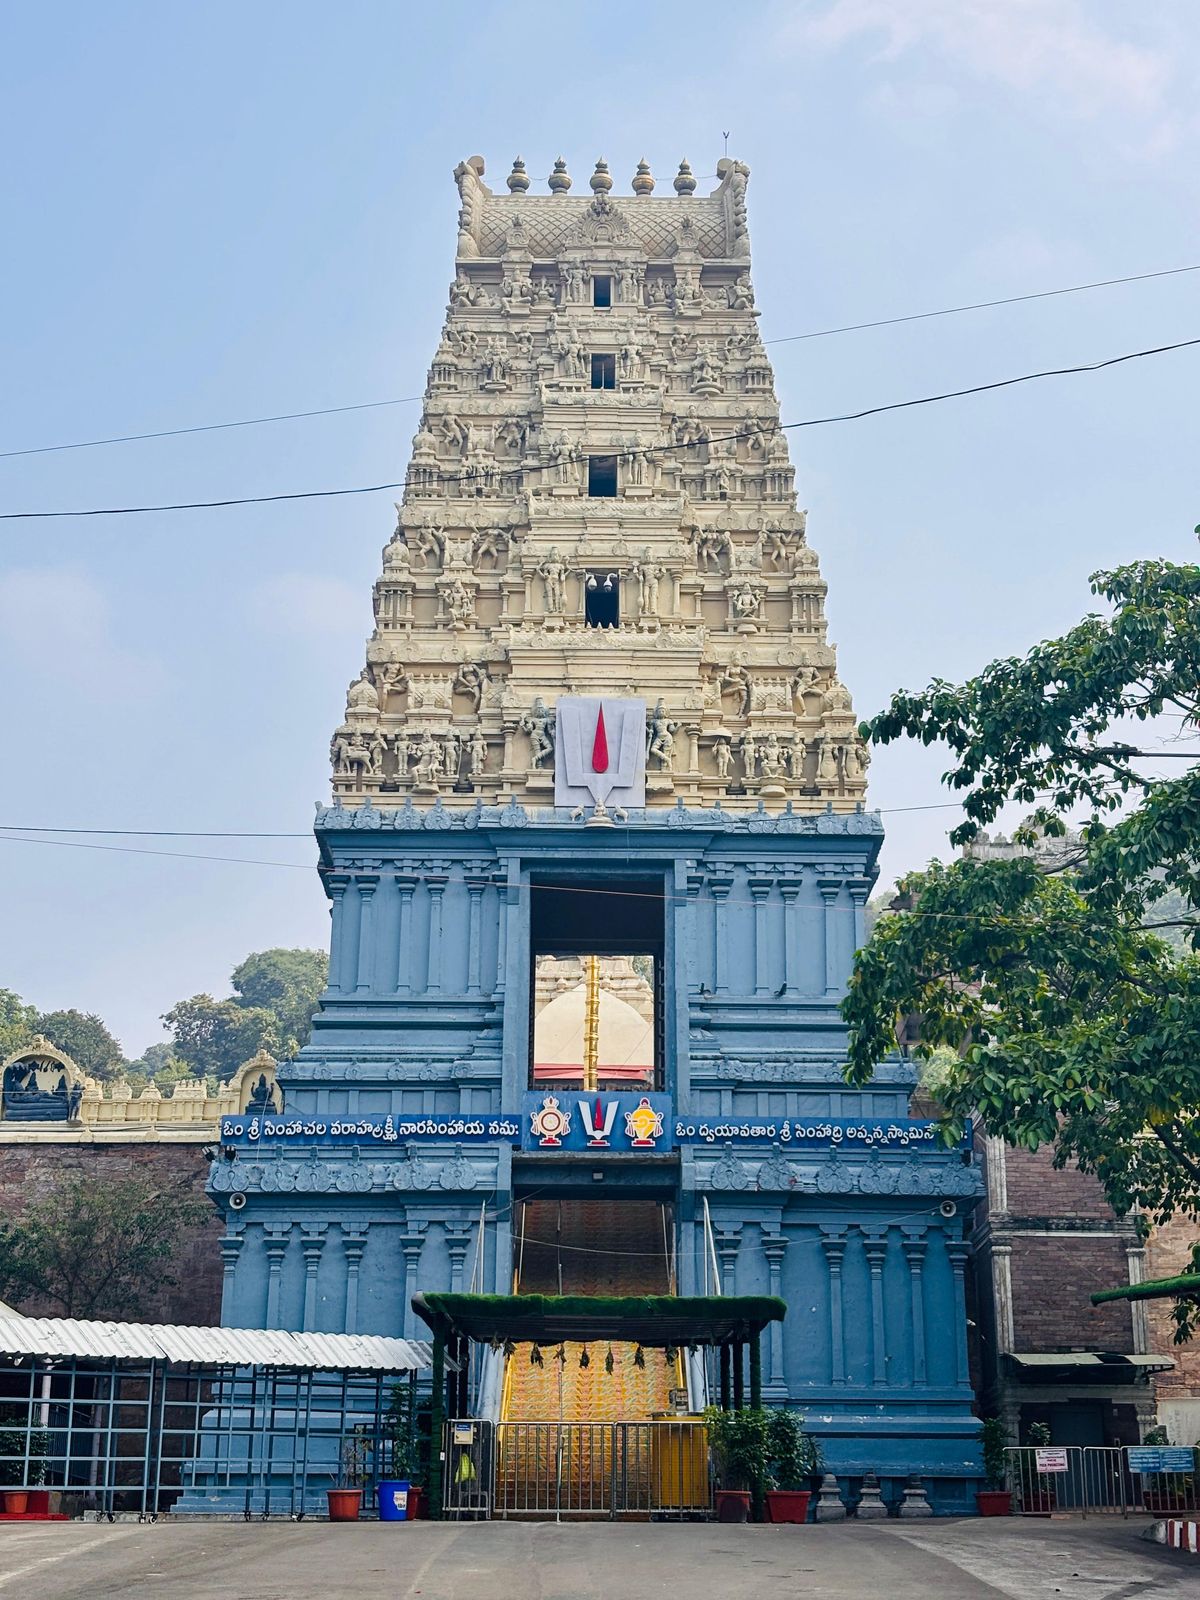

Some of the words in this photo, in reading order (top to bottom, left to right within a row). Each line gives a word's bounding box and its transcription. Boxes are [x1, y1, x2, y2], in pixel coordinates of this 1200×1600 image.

[223, 1121, 244, 1136] ఓం
[247, 1117, 261, 1140] శ్రీ
[264, 1120, 327, 1136] సింహాచల
[675, 1122, 696, 1137] ఓం
[698, 1123, 776, 1142] ద్వయావతార
[779, 1120, 793, 1142] శ్రీ
[795, 1123, 843, 1143] సింహాద్రి
